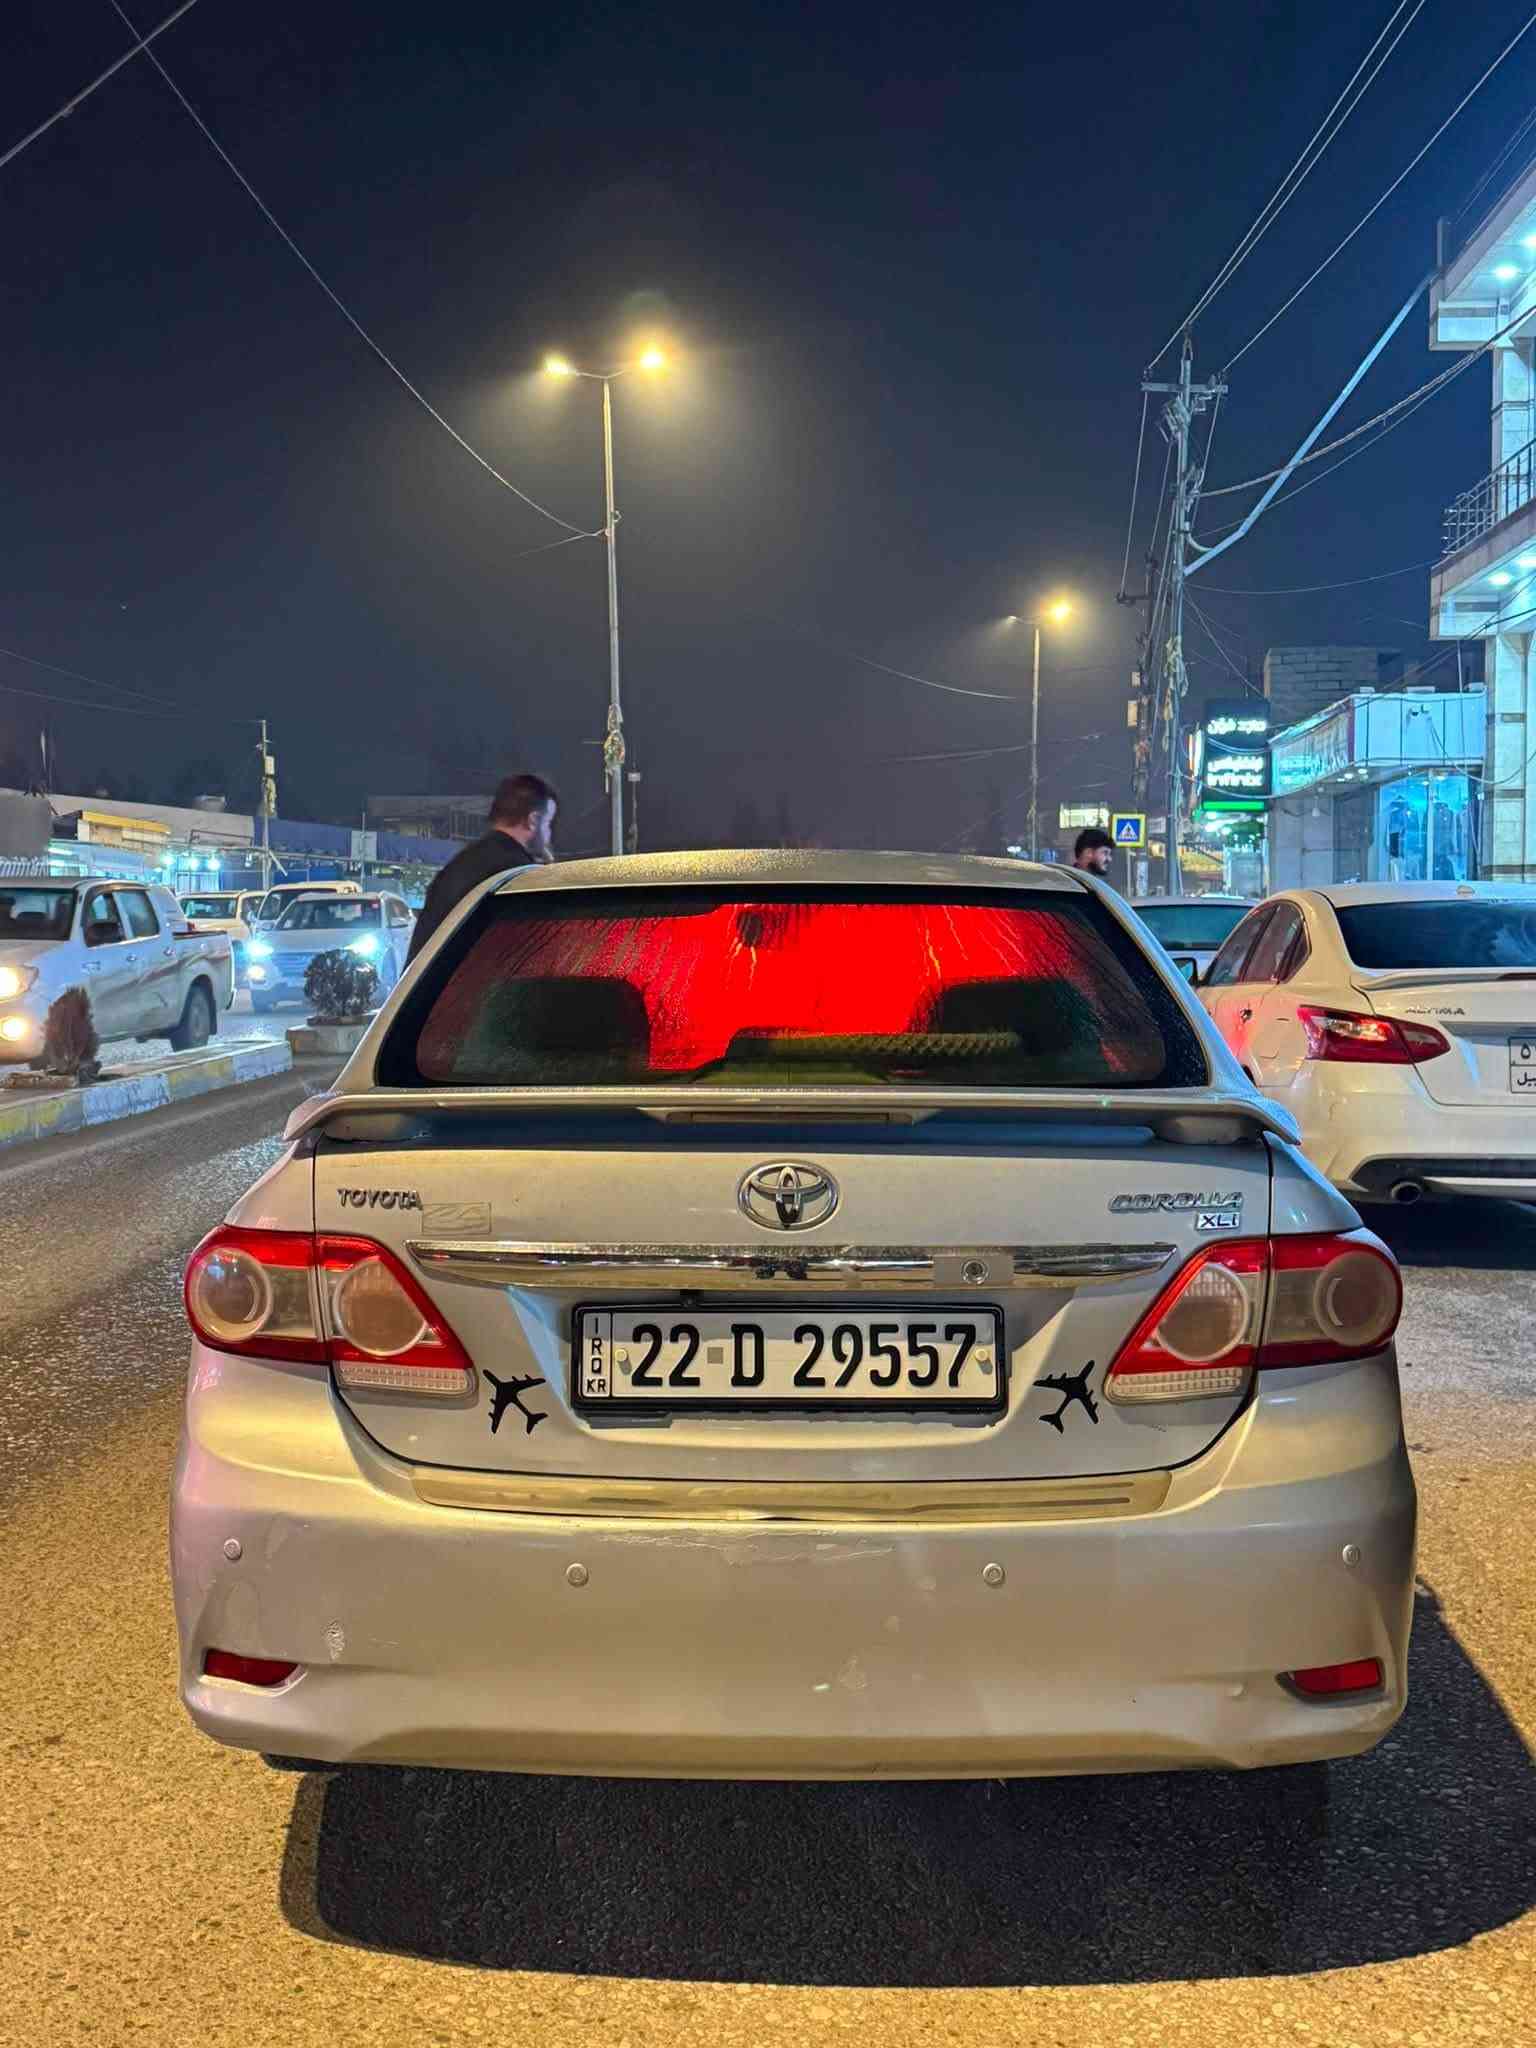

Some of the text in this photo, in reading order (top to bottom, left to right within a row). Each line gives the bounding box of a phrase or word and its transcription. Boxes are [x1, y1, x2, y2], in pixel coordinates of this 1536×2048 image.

[338, 1188, 424, 1211] TOYOTA
[1110, 1192, 1242, 1212] COROLLA
[631, 1323, 977, 1388] 22 D 29557
[586, 1378, 607, 1394] KR
